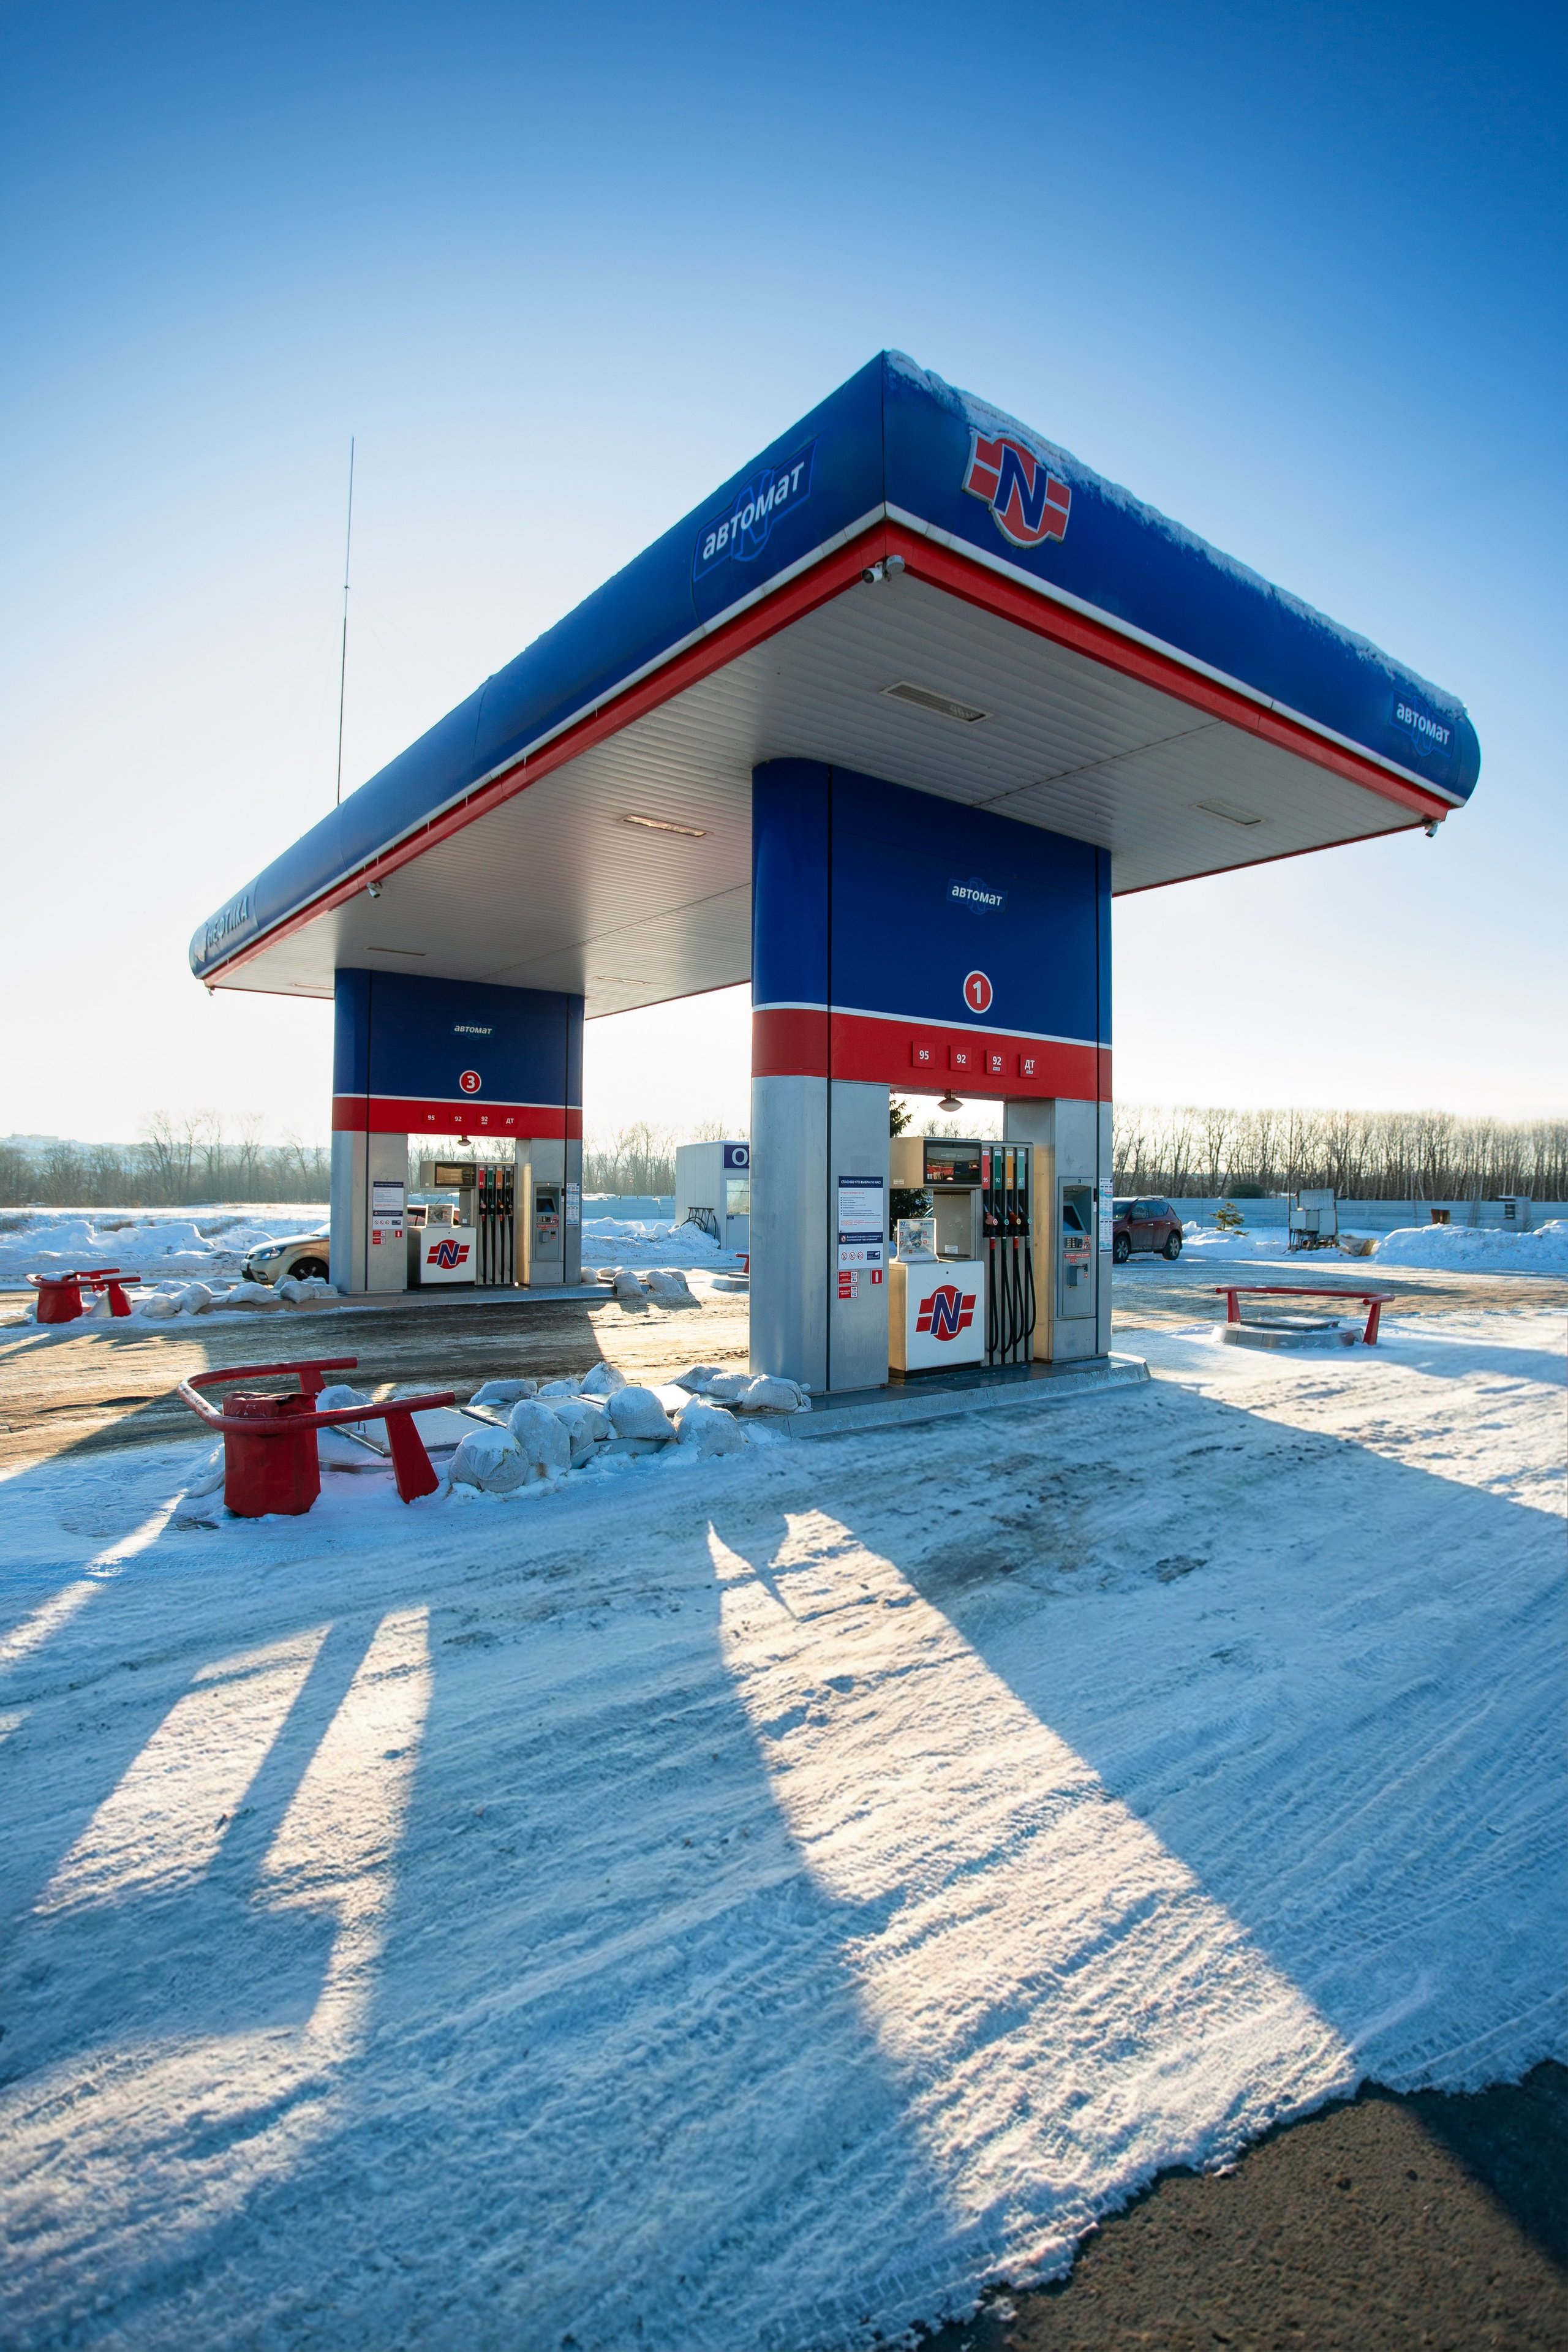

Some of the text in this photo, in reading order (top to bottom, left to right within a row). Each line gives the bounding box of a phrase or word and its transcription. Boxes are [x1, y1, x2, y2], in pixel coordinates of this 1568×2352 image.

[703, 461, 804, 560] автомат
[1396, 703, 1450, 745] автомат
[952, 885, 1003, 907] автомат
[973, 981, 981, 1004] 1
[454, 1025, 492, 1035] автомат
[919, 1050, 929, 1060] 95
[957, 1054, 967, 1064] 92
[992, 1056, 1002, 1066] 92
[1024, 1059, 1035, 1071] ДТ
[467, 1075, 475, 1089] 3
